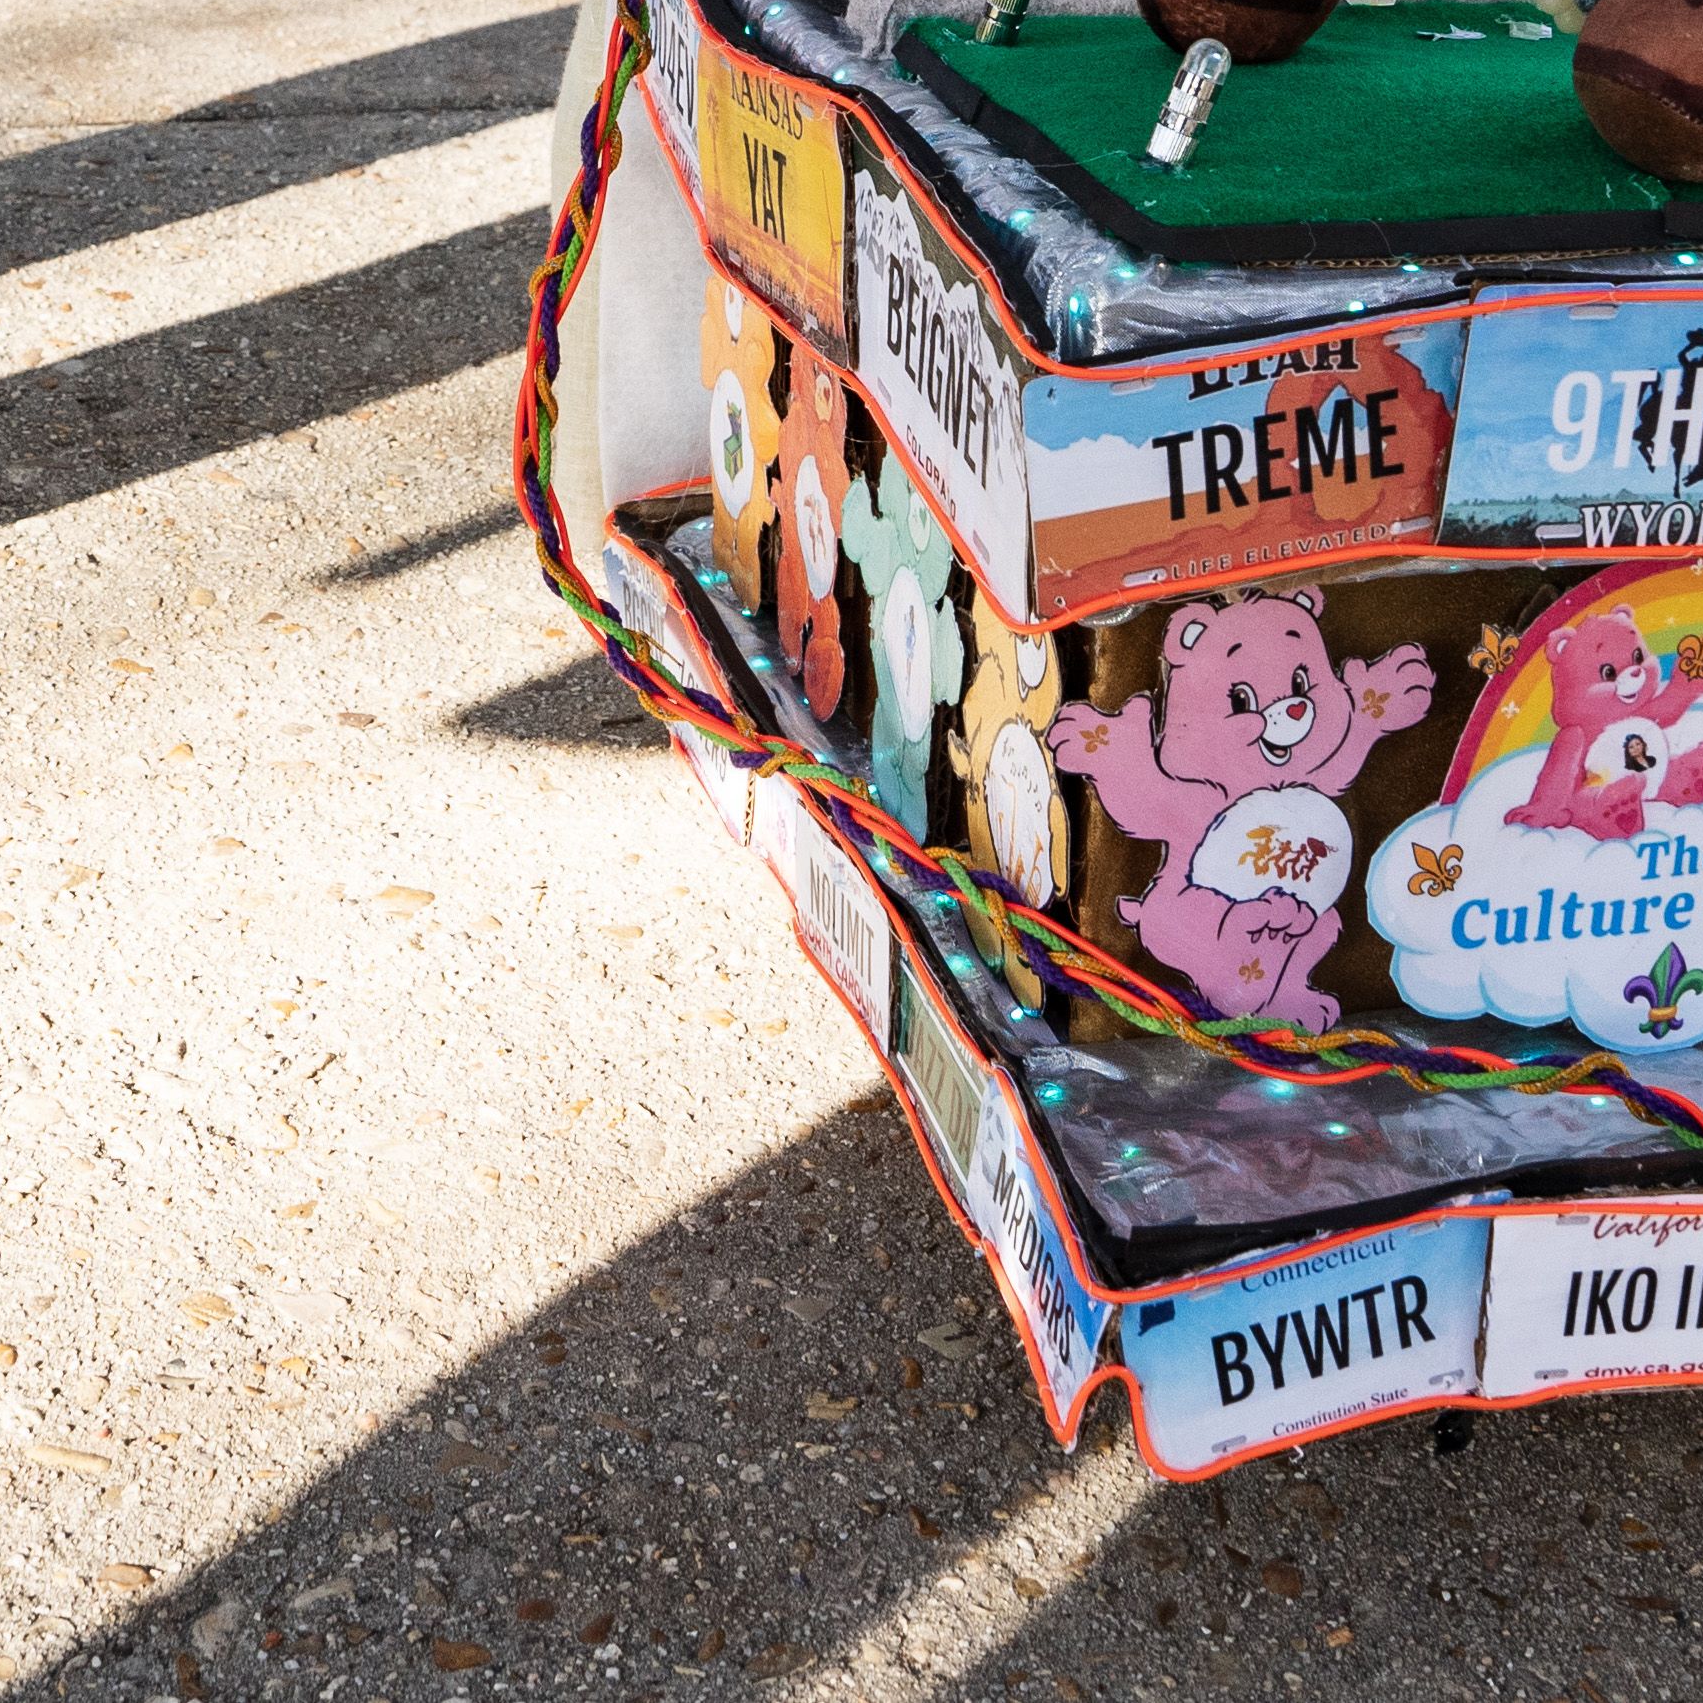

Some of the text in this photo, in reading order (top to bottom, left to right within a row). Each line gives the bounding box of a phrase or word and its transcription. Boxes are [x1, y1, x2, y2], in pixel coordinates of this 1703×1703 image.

[730, 66, 804, 140] KANSAS
[743, 132, 787, 246] YAT
[886, 252, 994, 491] BEIGNET
[906, 424, 956, 522] COLORAO
[1151, 389, 1405, 521] TREME
[1171, 524, 1389, 581] LIFE ELEVATED
[809, 857, 875, 986] NOLIMIT
[1451, 886, 1695, 951] Culture
[835, 957, 884, 1036] CAROLINA
[992, 1149, 1076, 1367] MRDIGRS
[1241, 1233, 1397, 1294] Connecticut
[1562, 1266, 1658, 1337] IKO
[1210, 1274, 1437, 1407] BYWTR
[1272, 1386, 1409, 1438] Constitution State
